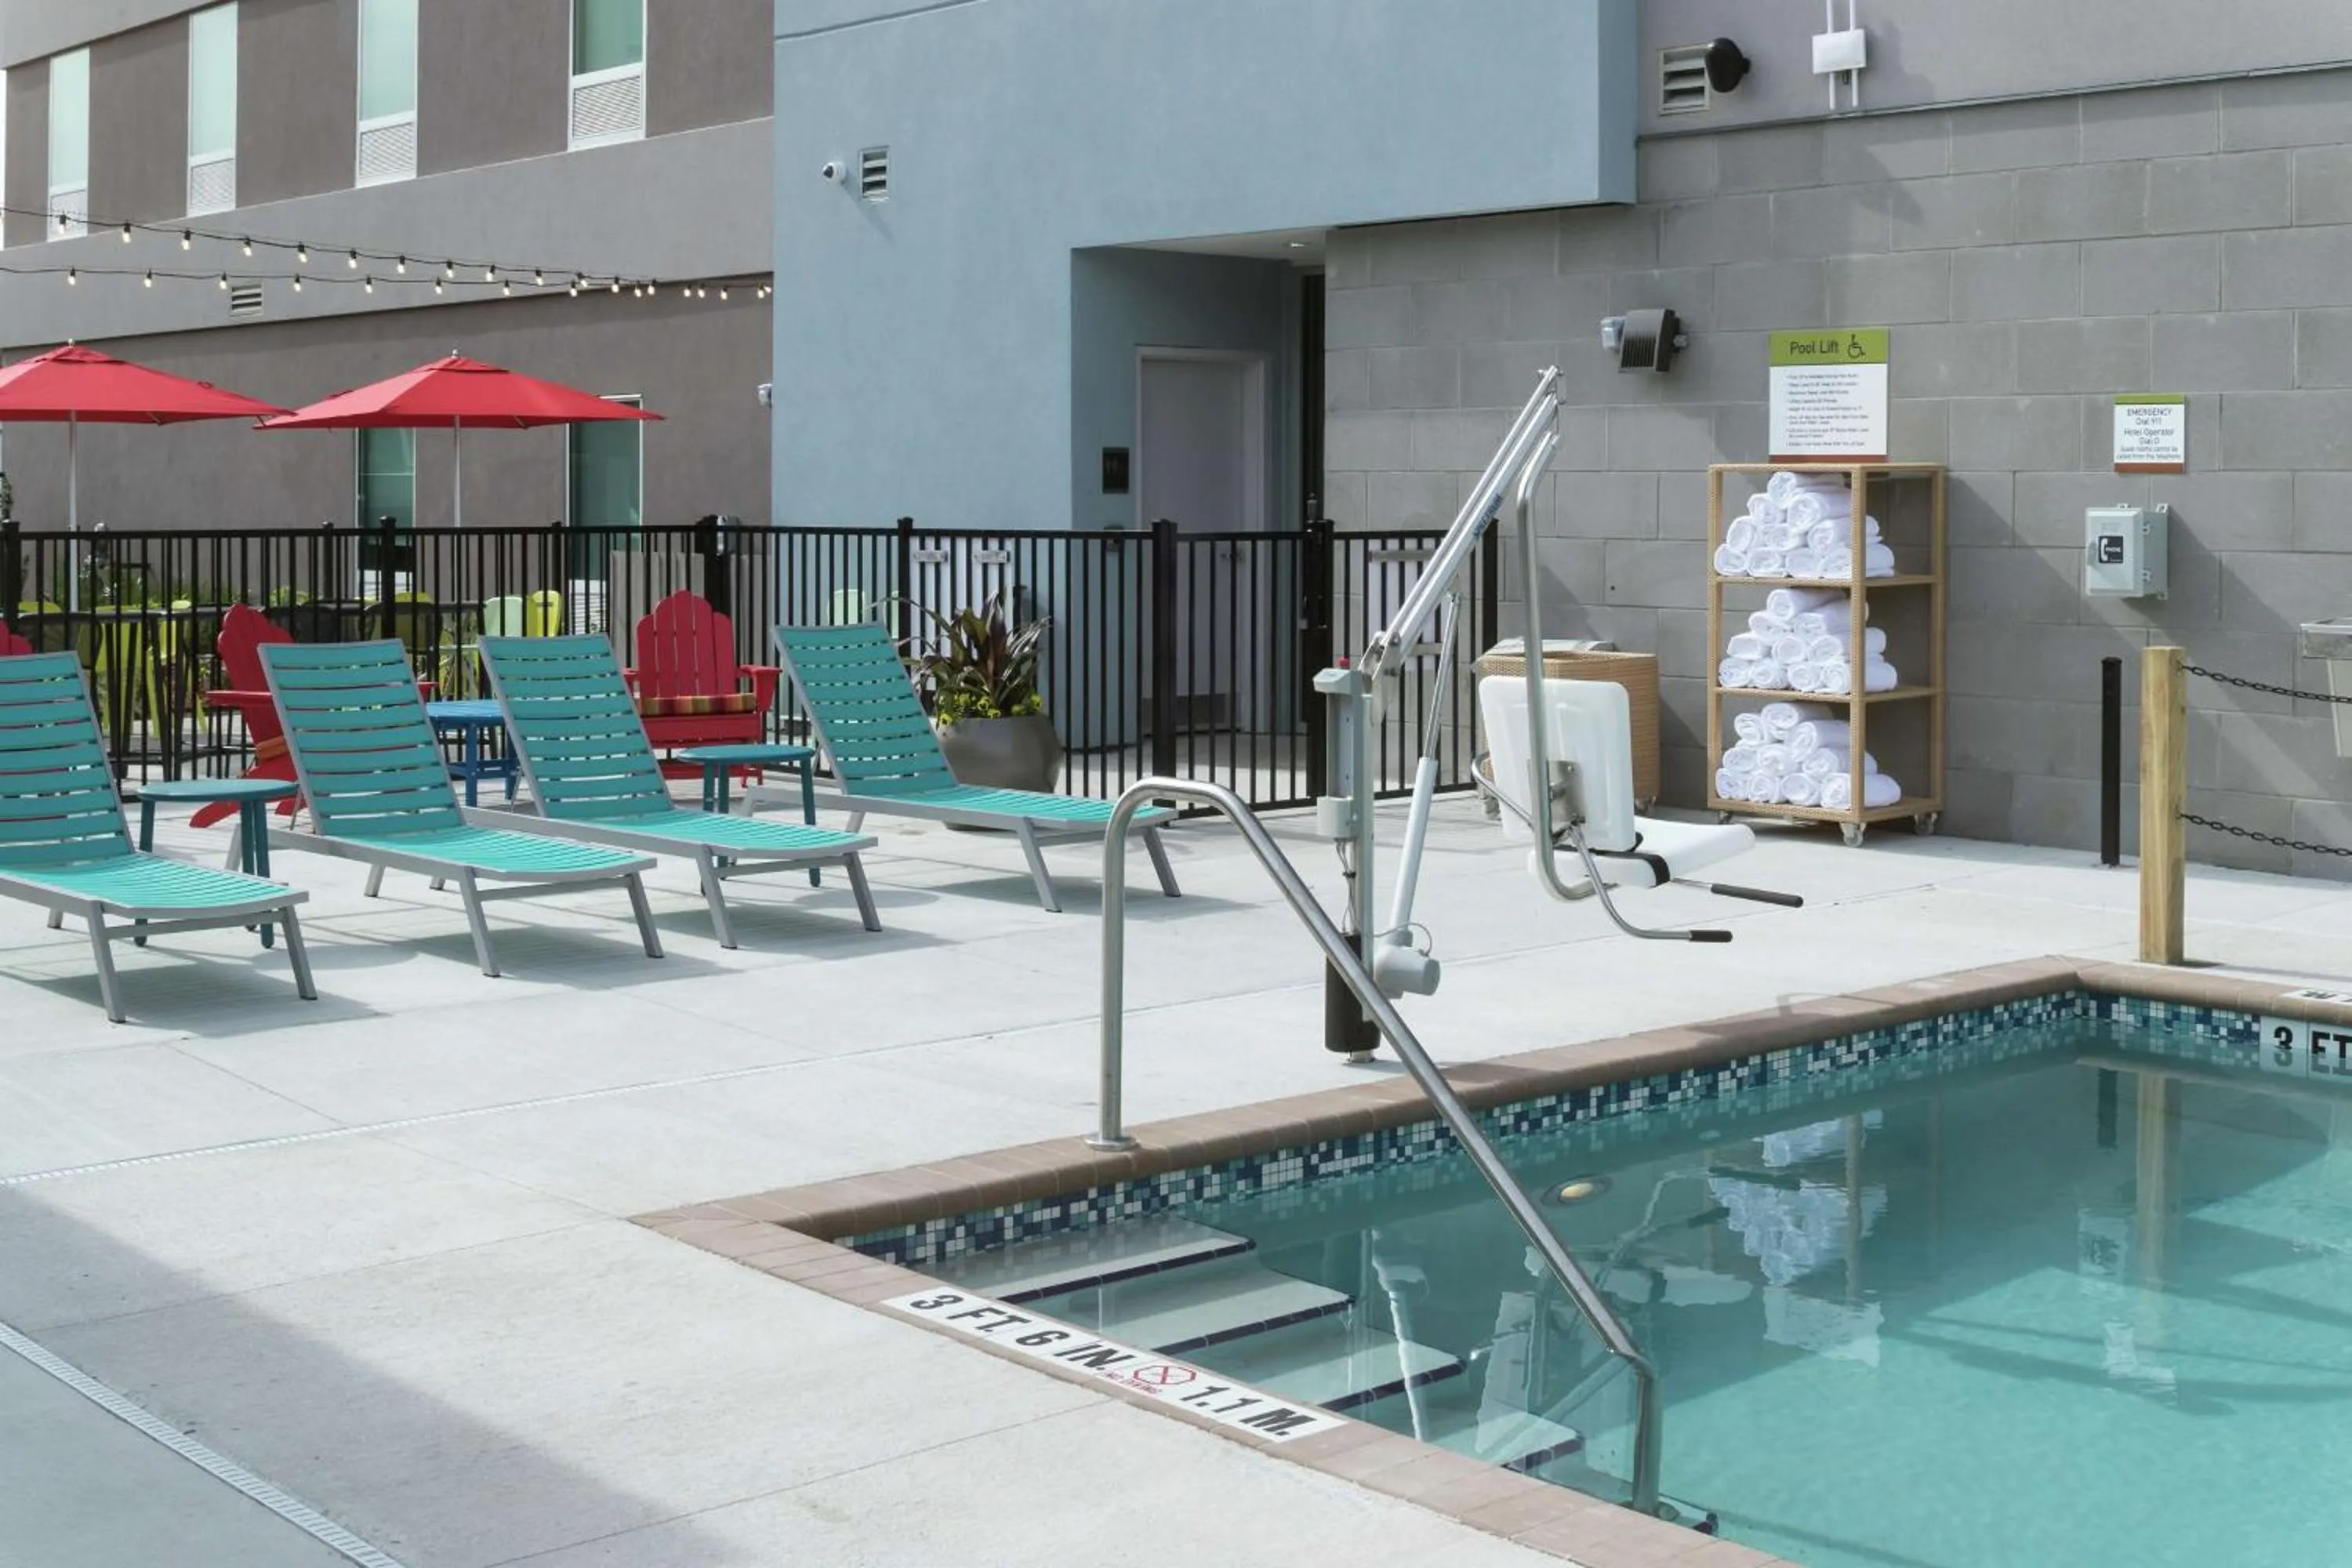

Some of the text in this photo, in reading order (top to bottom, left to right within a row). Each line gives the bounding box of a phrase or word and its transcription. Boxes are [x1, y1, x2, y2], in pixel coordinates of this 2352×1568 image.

[1790, 339, 1839, 355] Pool Lift
[2127, 408, 2172, 416] EMERGENCY
[909, 1294, 1136, 1370] 3 FT. 6 IN.
[1179, 1386, 1317, 1436] 1.1 M.
